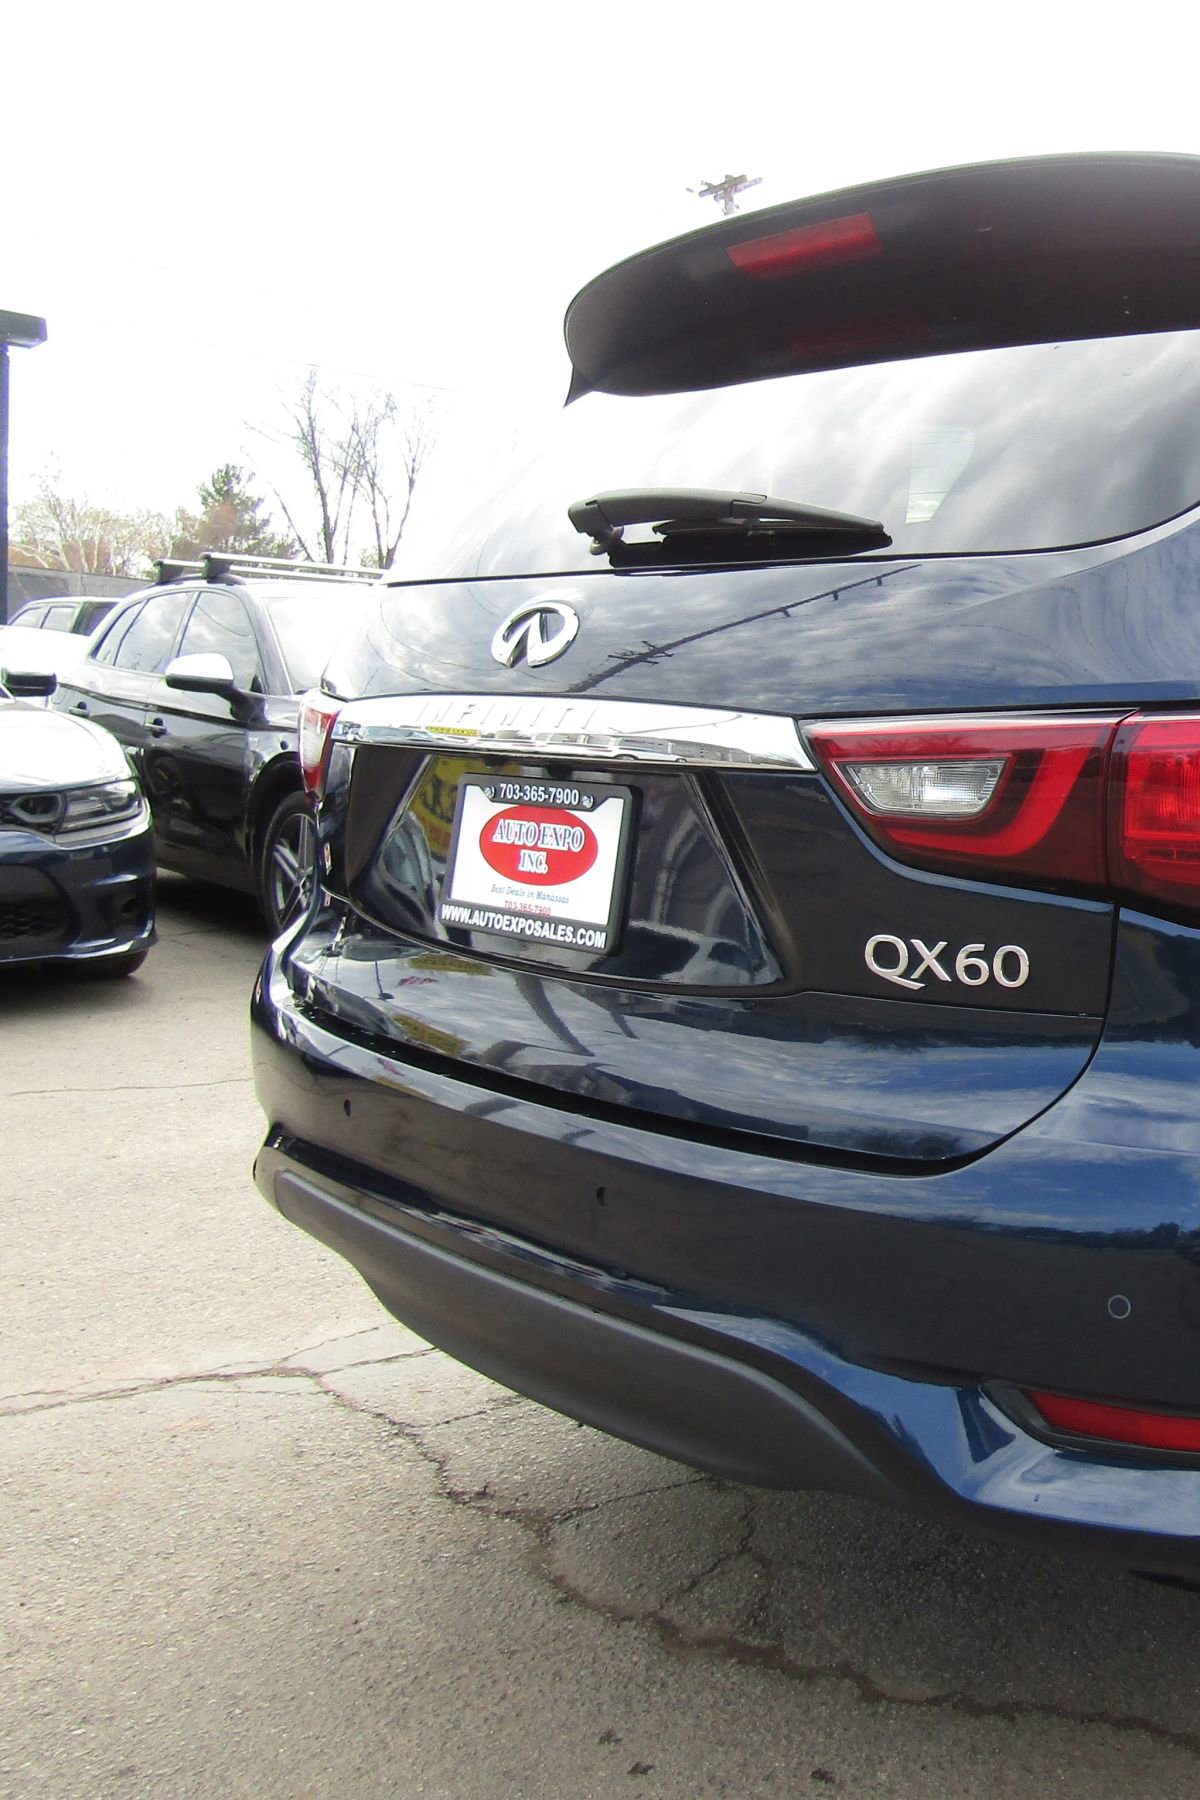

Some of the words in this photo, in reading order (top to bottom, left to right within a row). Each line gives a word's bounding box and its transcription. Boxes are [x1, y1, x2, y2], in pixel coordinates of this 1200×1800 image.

[499, 783, 580, 806] 703-365-7900
[493, 818, 538, 847] AUTO
[539, 822, 585, 852] EXPO
[518, 849, 549, 874] INC.
[490, 883, 505, 894] Best
[506, 886, 526, 897] Deals
[527, 889, 535, 898] in
[536, 890, 570, 904] Manassas
[441, 903, 607, 948] WWW.AUTOEXPOSALES.COM
[864, 934, 1030, 990] QX60
